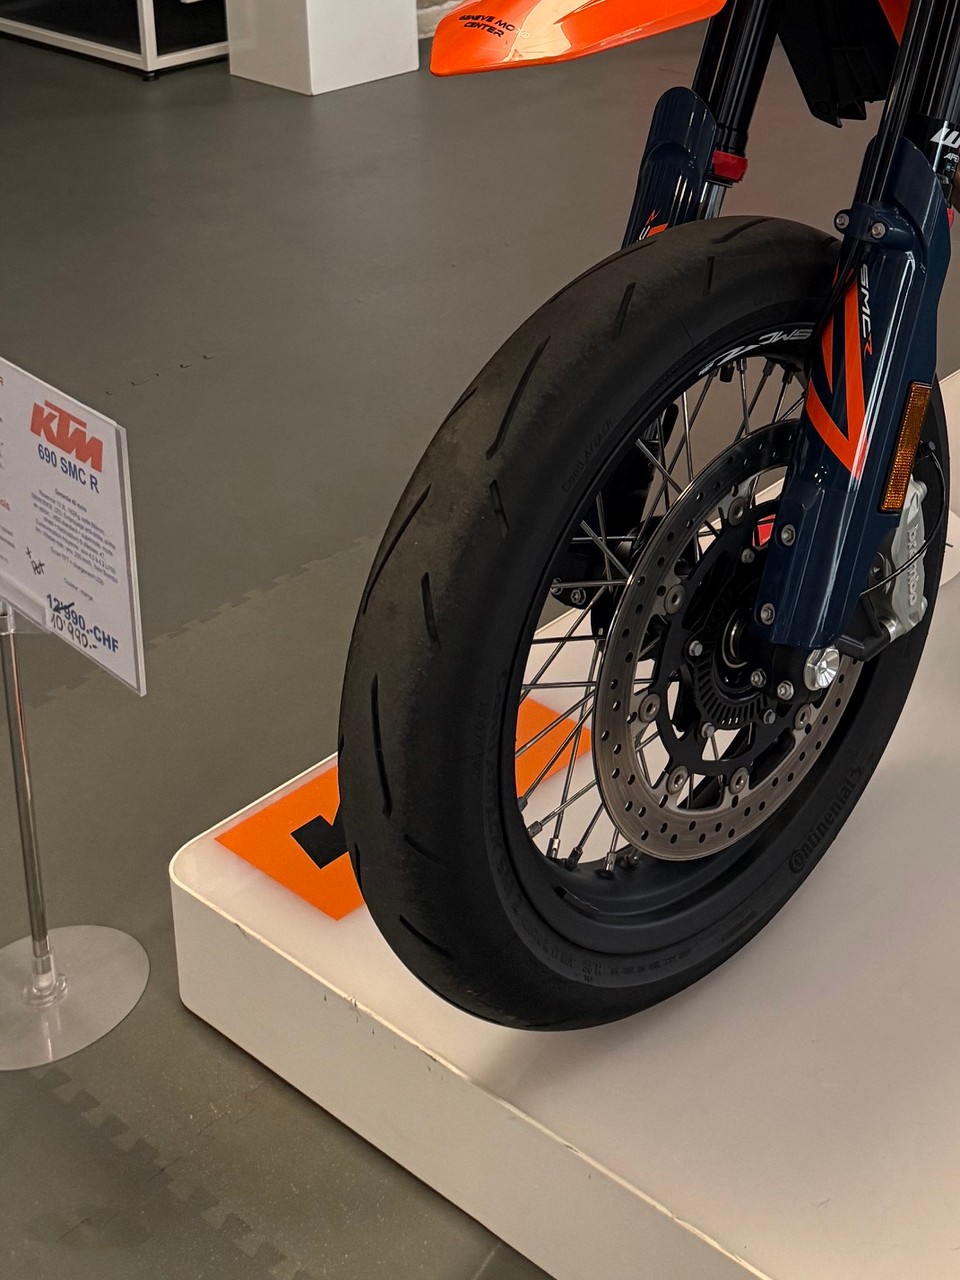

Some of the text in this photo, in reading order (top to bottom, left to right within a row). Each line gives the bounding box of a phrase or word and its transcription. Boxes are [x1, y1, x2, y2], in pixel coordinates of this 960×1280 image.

[464, 21, 504, 38] CENTER
[860, 263, 872, 339] SMC
[30, 399, 104, 473] KTM
[38, 443, 99, 494] 690 SMC R
